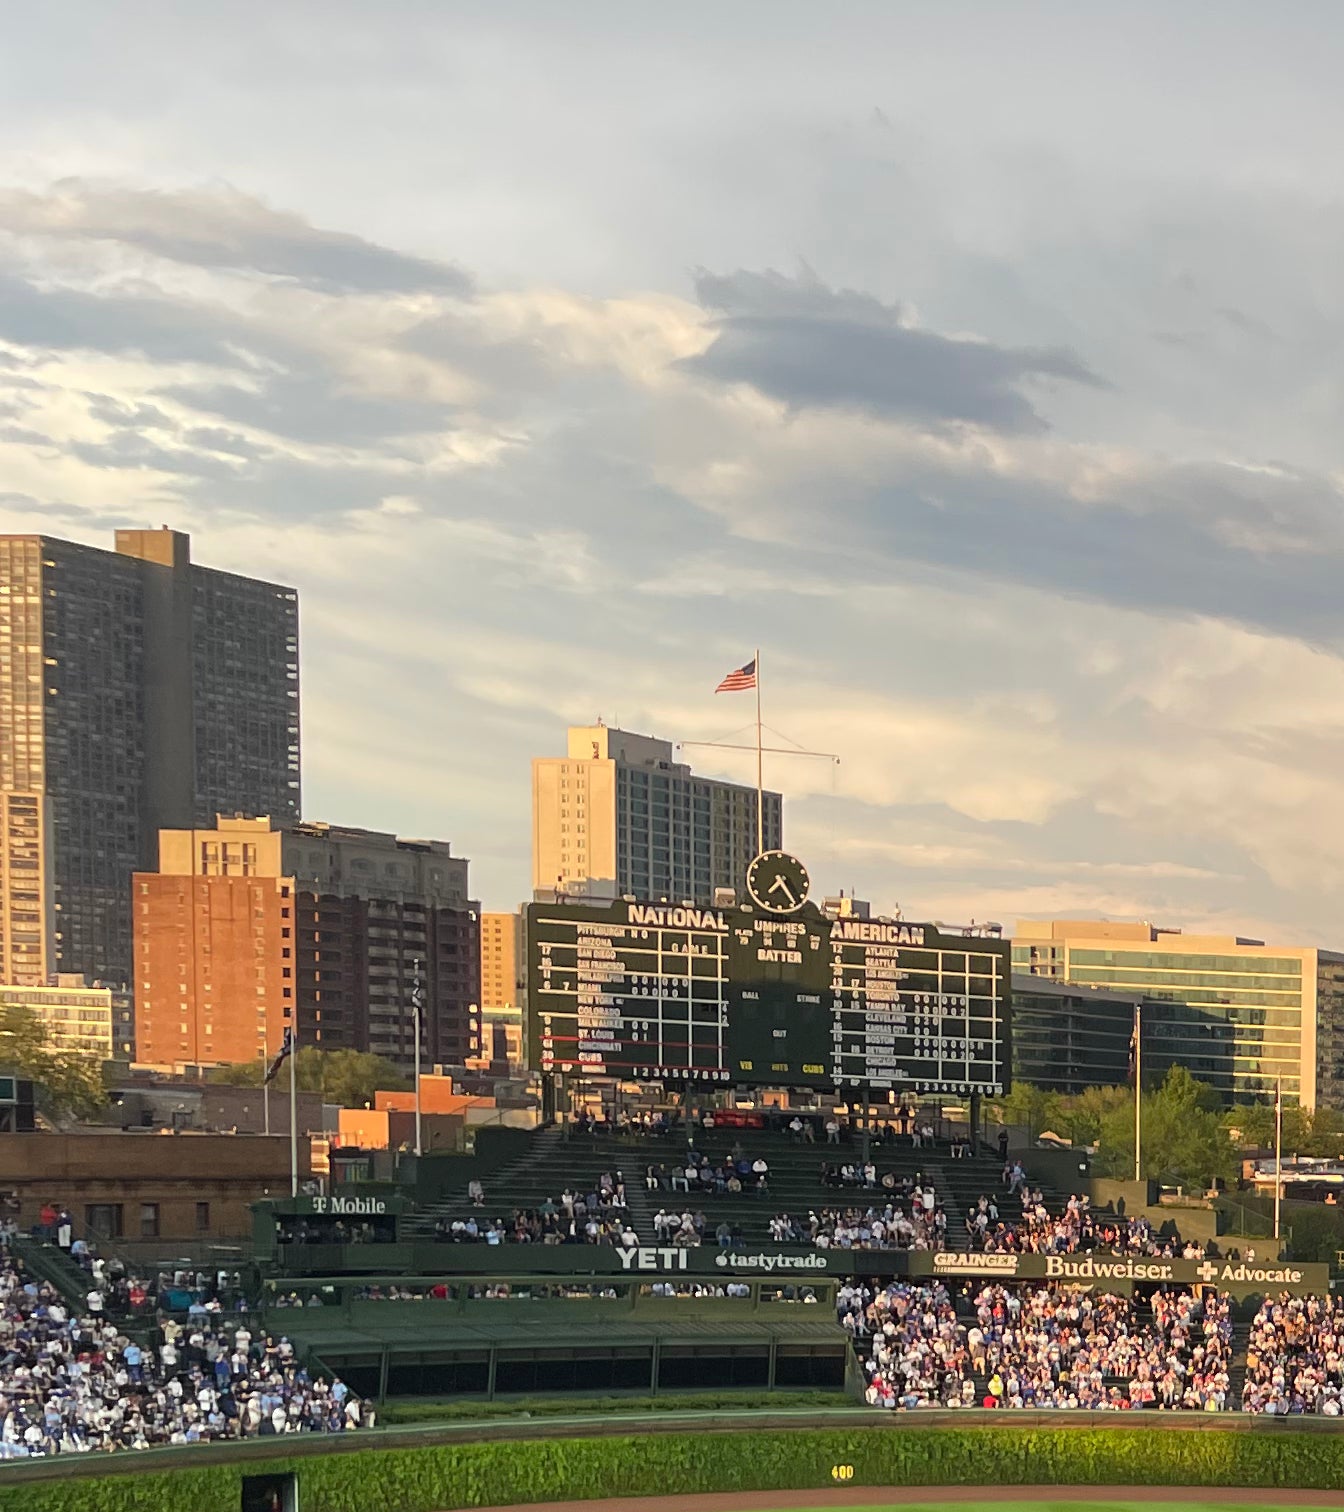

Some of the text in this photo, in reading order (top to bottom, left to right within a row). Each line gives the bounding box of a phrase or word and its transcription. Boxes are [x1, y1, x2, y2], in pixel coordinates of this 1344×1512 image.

[628, 904, 729, 930] NATIONAL
[754, 920, 806, 935] UMPIRES
[830, 921, 924, 945] AMERICAN
[577, 937, 612, 947] ARIZONA
[757, 948, 802, 963] BATTER
[865, 947, 899, 958] ATLANTA
[865, 957, 896, 968] SEATTLE
[331, 1198, 385, 1213] Mobile
[615, 1248, 688, 1269] YETI
[730, 1252, 827, 1271] tastytrade
[934, 1253, 1018, 1268] GRAINGER
[1221, 1265, 1301, 1283] Advocate
